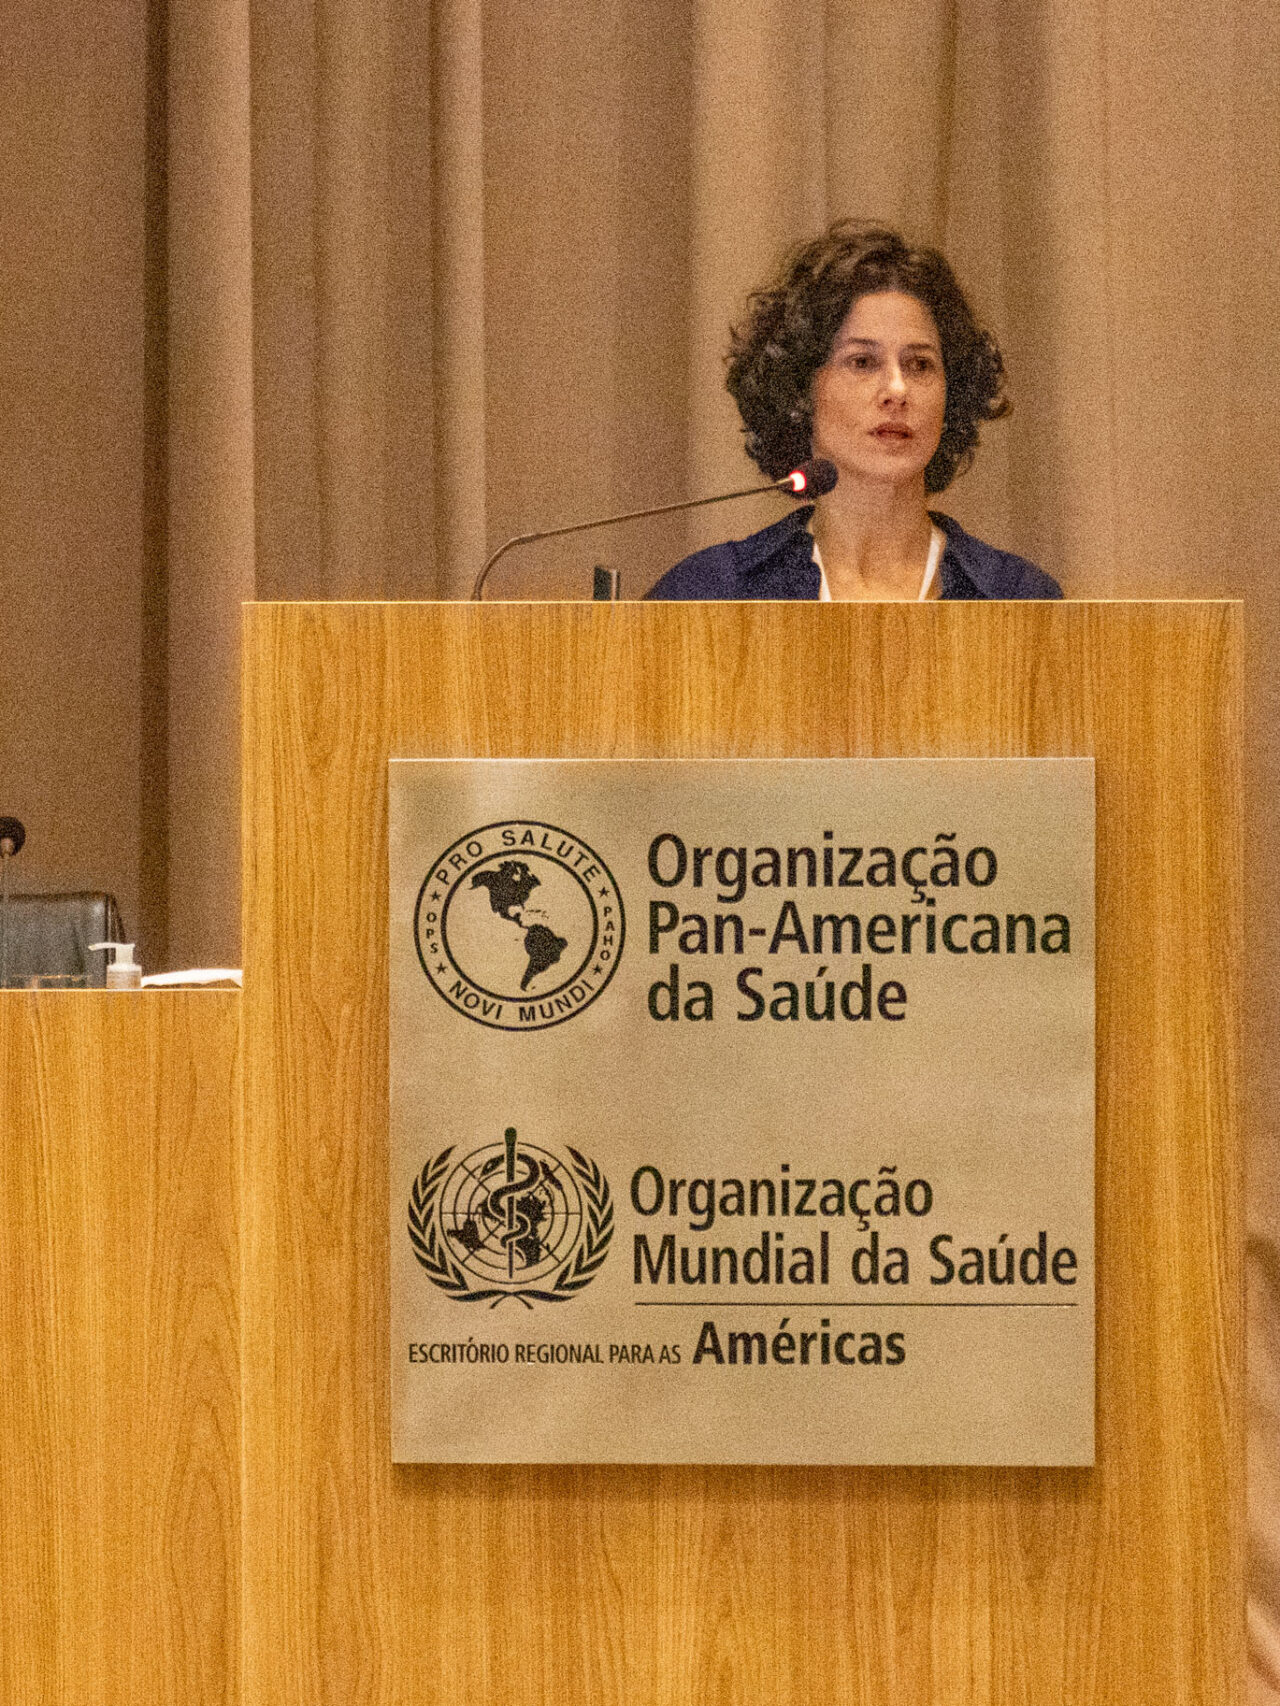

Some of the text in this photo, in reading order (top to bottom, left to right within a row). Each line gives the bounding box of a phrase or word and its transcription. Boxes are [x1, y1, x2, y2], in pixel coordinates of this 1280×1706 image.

[435, 829, 601, 885] PRO SALUTE
[647, 830, 998, 903] Organização
[426, 911, 439, 954] OPS
[600, 906, 616, 961] PAHO
[649, 898, 1071, 955] Pan-Americana
[449, 979, 595, 1022] NOVI MUNDI
[647, 963, 908, 1022] da Saúde
[630, 1164, 933, 1231] Organização
[633, 1231, 1078, 1286] Mundial da Saúde
[407, 1318, 906, 1366] ESCRITÓRIO REGIONAL PARA AS Américas
